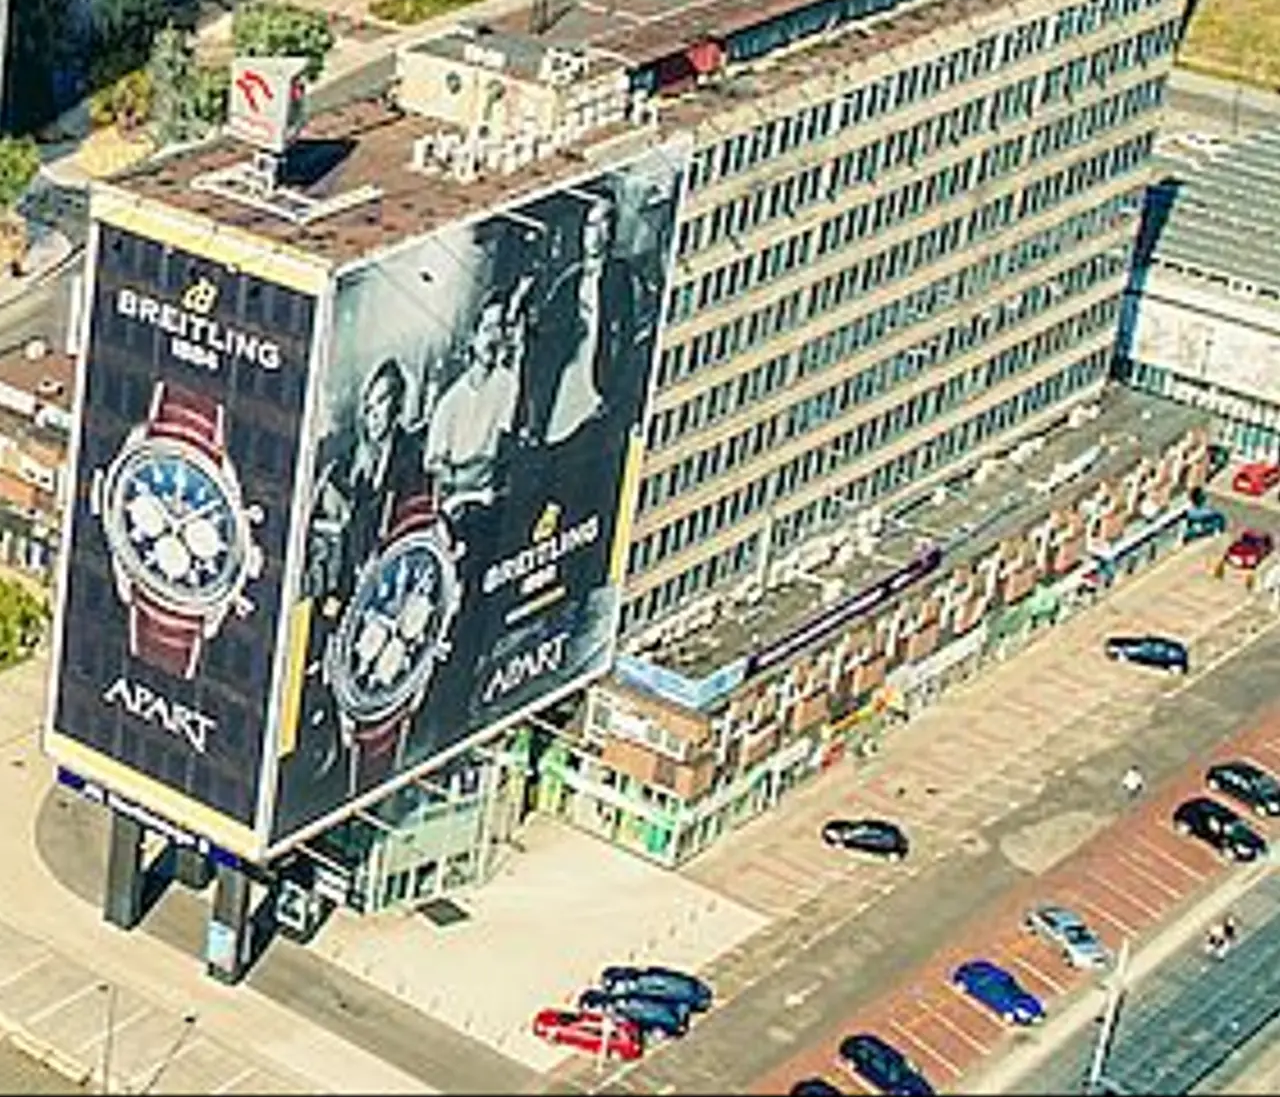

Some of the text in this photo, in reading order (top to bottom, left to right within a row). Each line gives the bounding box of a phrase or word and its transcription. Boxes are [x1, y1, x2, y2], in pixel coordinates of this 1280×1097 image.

[117, 288, 282, 370] BREITLING
[482, 513, 599, 593] BREITLING
[482, 632, 570, 703] APART
[102, 678, 217, 754] APART
